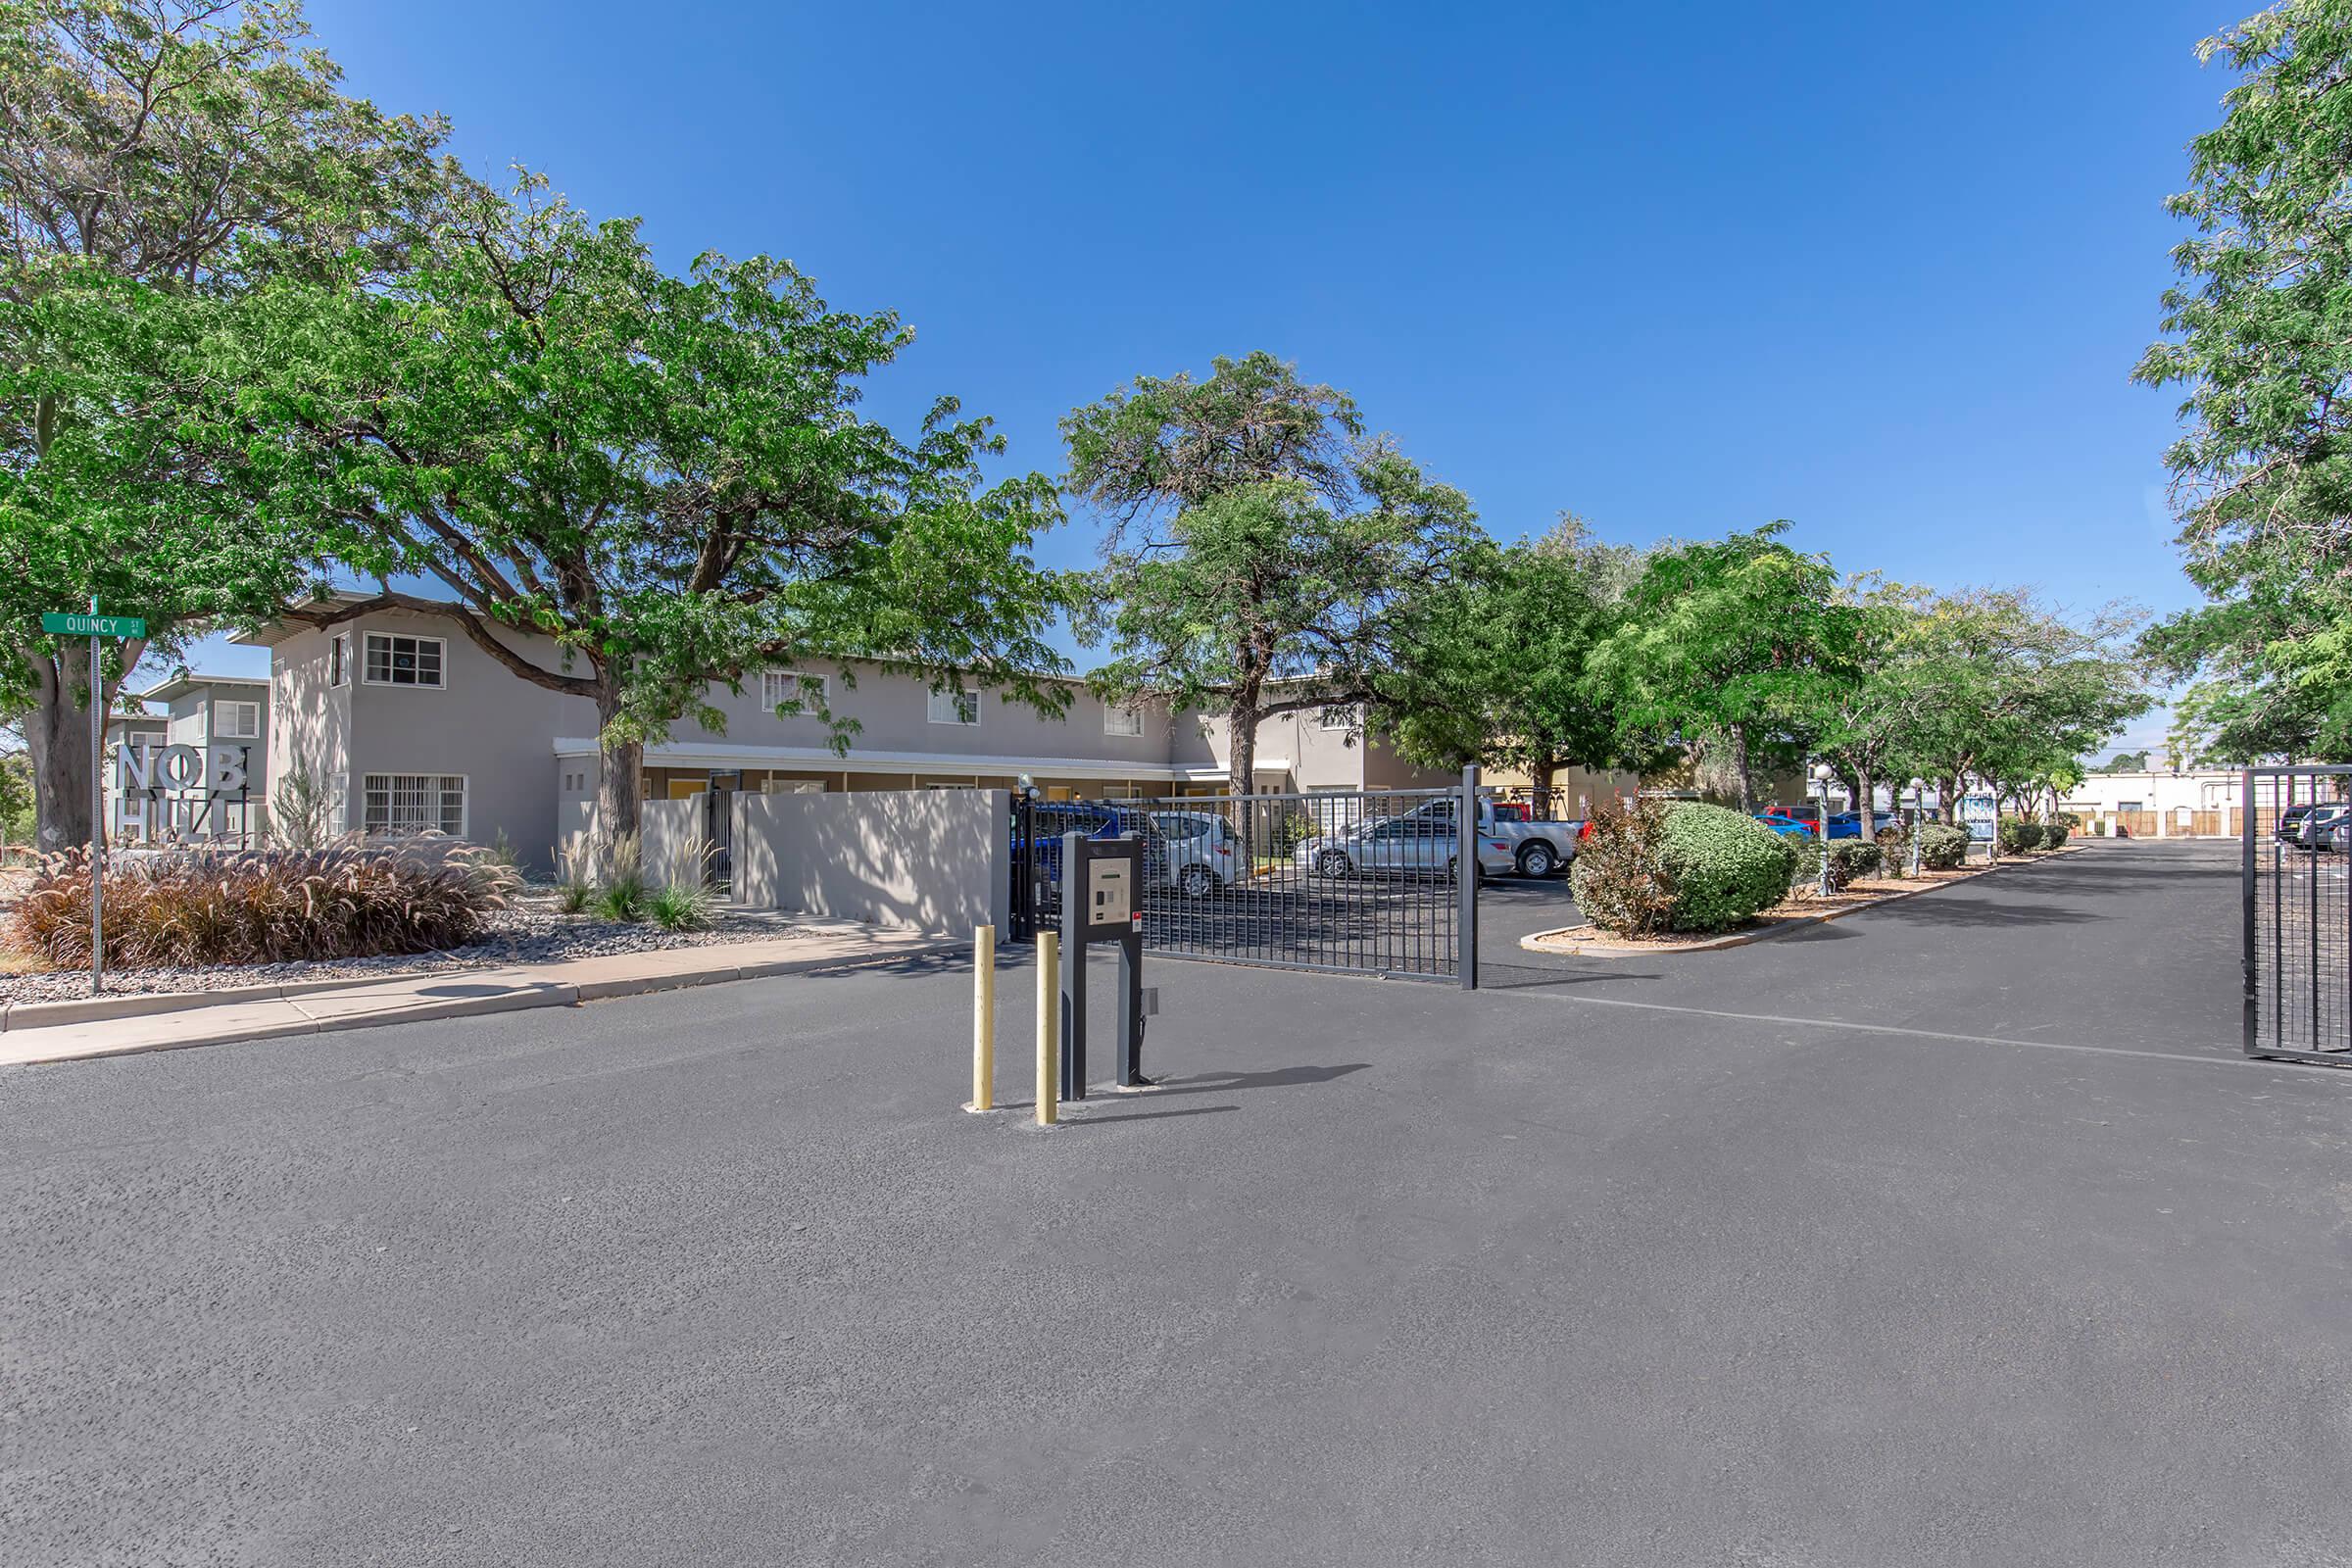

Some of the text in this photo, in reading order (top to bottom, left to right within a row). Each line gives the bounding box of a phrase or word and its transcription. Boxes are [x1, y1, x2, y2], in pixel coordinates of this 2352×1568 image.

[66, 617, 118, 633] QUINCY
[117, 743, 246, 791] NOB
[116, 797, 242, 845] HILL
